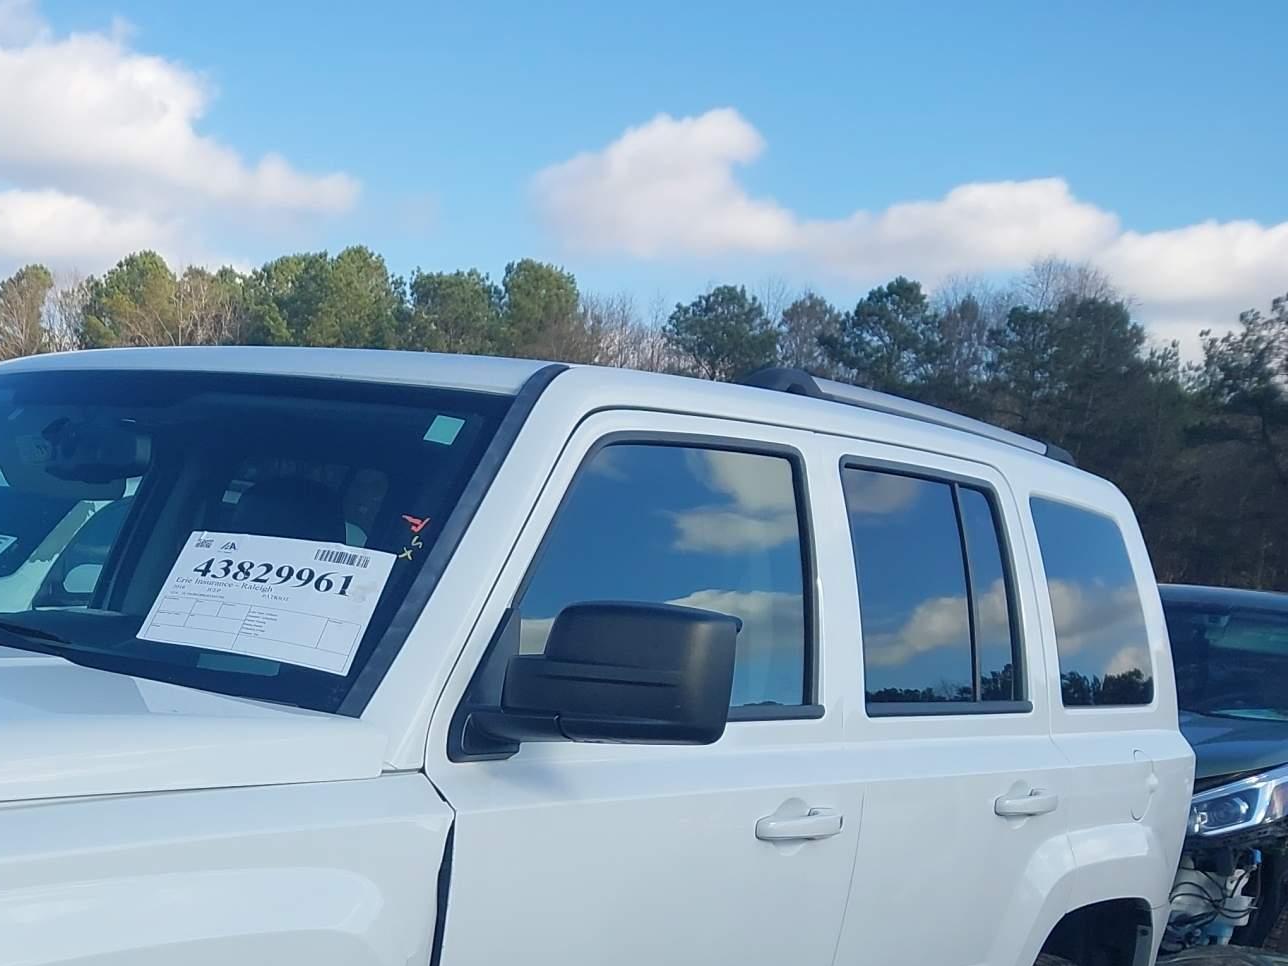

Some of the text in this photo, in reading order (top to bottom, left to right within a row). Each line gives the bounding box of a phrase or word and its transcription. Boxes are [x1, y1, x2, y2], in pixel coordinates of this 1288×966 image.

[176, 576, 193, 584] Erie
[194, 577, 234, 588] Insurance
[240, 582, 274, 593] Raleigh
[193, 557, 354, 596] 43829961
